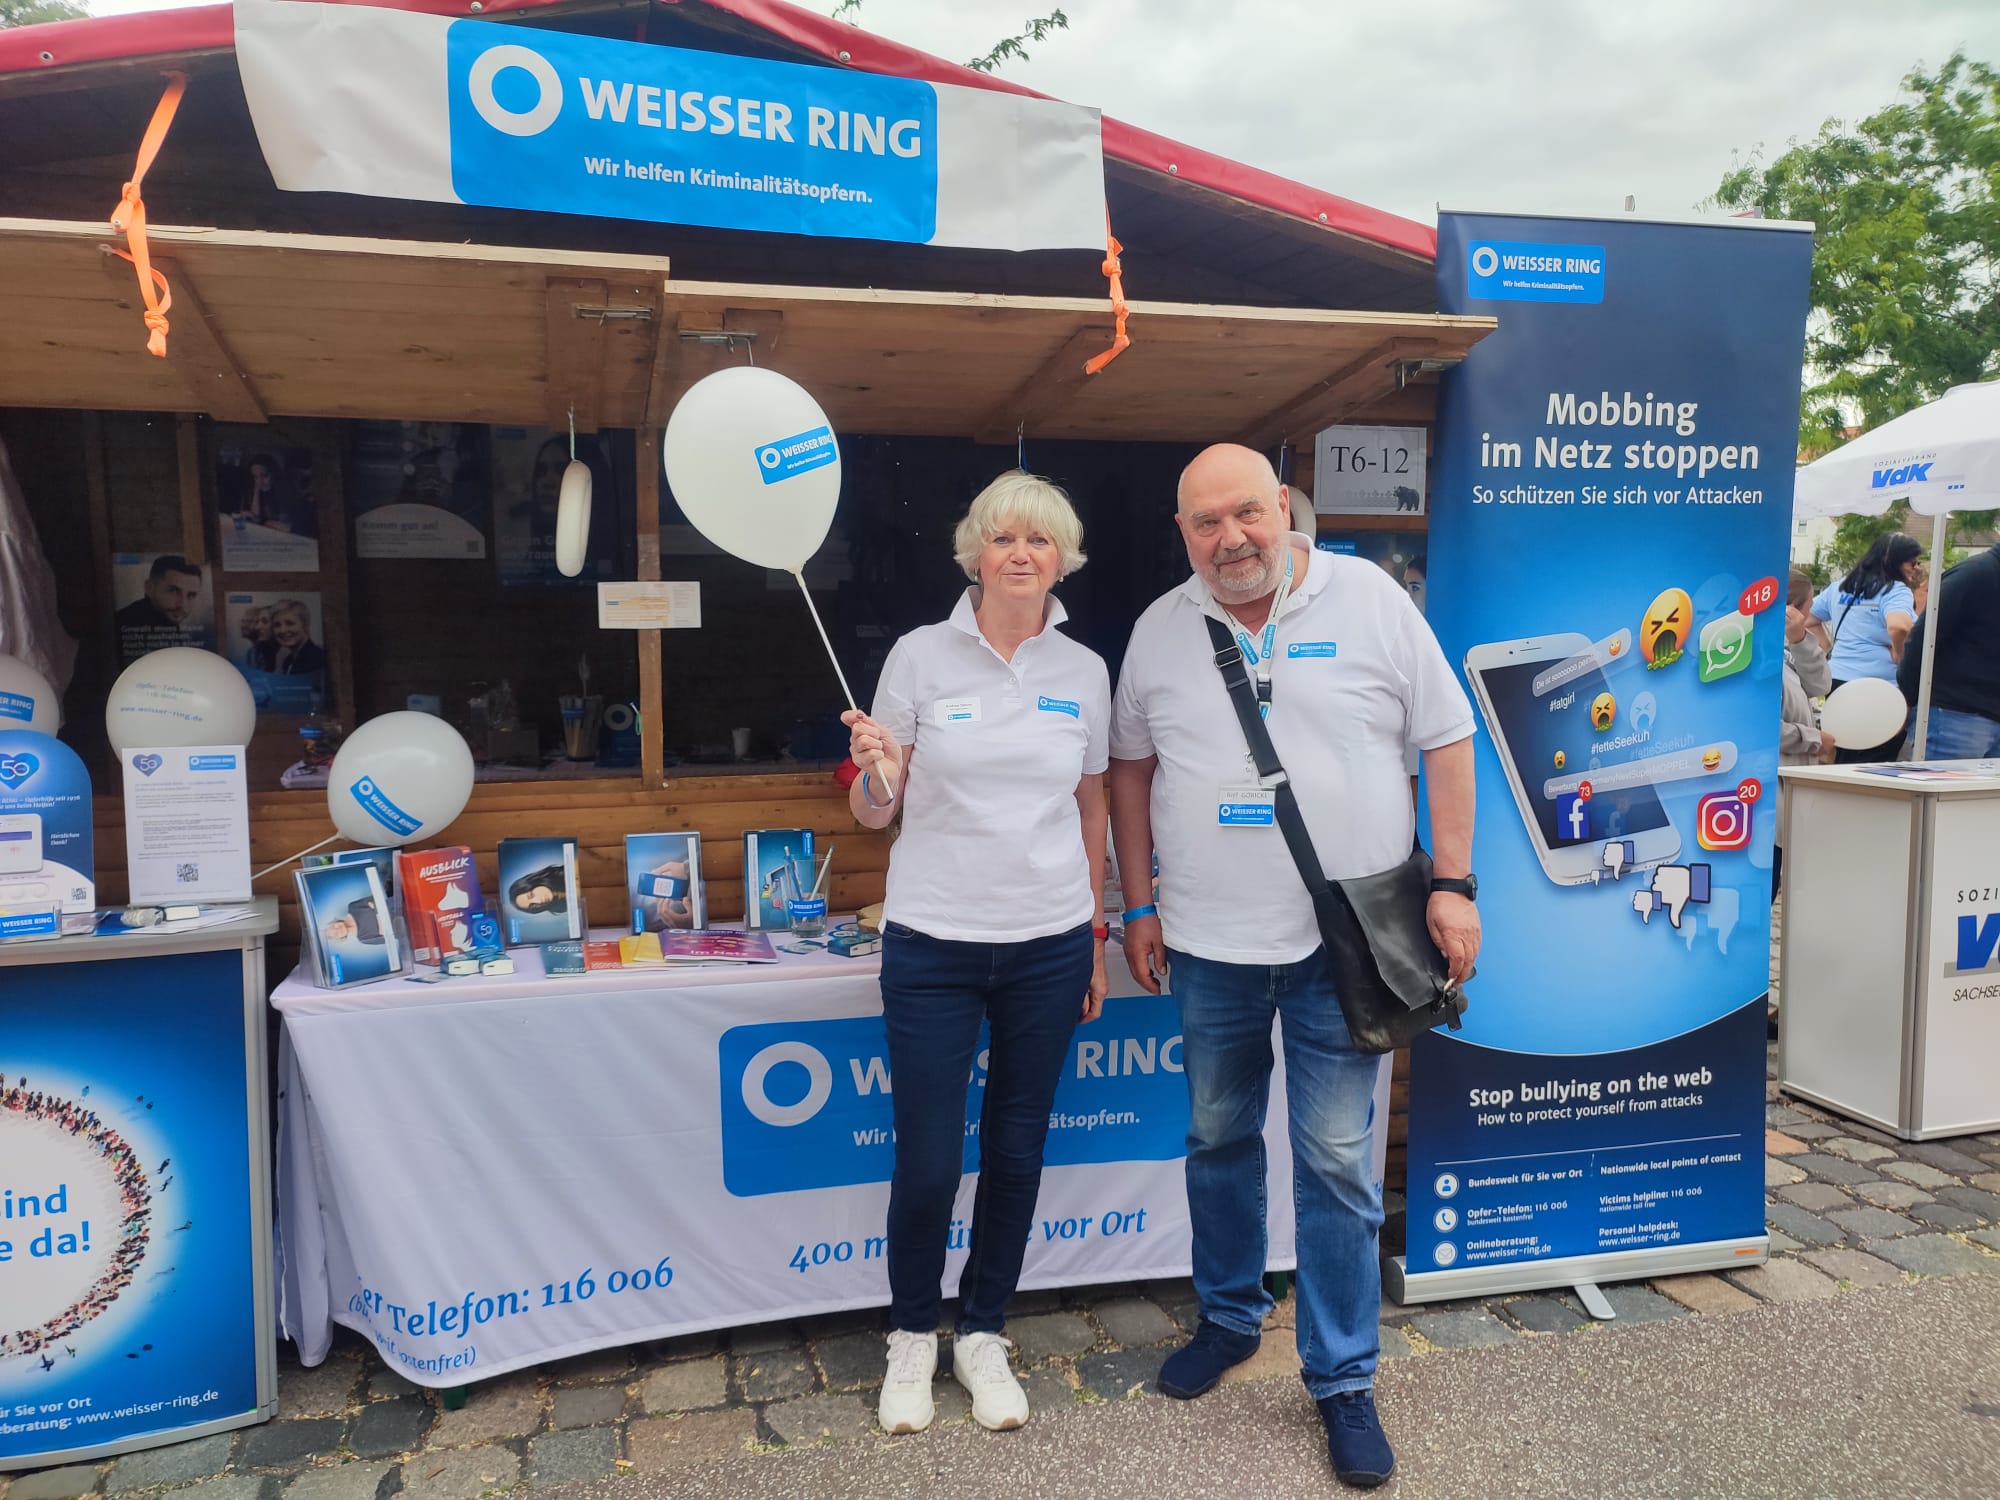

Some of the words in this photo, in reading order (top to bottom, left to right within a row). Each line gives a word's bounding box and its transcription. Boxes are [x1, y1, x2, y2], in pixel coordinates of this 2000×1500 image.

[579, 77, 795, 143] WEISSER
[808, 106, 921, 158] RING
[584, 156, 620, 177] Wir
[624, 159, 684, 184] helfen
[690, 167, 873, 203] Kriminalitätsopfern.
[1502, 255, 1562, 273] WEISSER
[1565, 258, 1600, 274] RING
[1546, 391, 1698, 436] Mobbing
[781, 438, 819, 458] WEISSER
[1481, 433, 1521, 468] im
[1534, 436, 1612, 469] Netz
[1624, 439, 1759, 479] stoppen
[1331, 446, 1409, 474] T6-12
[1872, 462, 1934, 488] VdK
[1472, 485, 1494, 504] So
[1499, 485, 1575, 504] schützen
[1581, 485, 1606, 504] Sie
[1613, 485, 1647, 504] sich
[1653, 491, 1681, 504] vor
[1685, 485, 1763, 504] Attacken
[1744, 585, 1771, 609] 118
[0, 760, 30, 780] 50
[1580, 786, 1590, 797] 73
[1739, 784, 1757, 798] 20
[371, 793, 400, 820] WEISSER
[398, 818, 418, 830] RING
[419, 857, 470, 878] AUSBLICK
[2, 919, 33, 928] WEISSER
[34, 917, 52, 925] RING
[1469, 1087, 1514, 1108] Stop
[1521, 1079, 1602, 1104] bullying
[1607, 1078, 1631, 1095] on
[1638, 1071, 1668, 1092] the
[1674, 1066, 1712, 1087] web
[1478, 1112, 1505, 1126] How
[1509, 1110, 1523, 1123] to
[1527, 1106, 1572, 1125] protect
[1575, 1100, 1626, 1122] yourself
[1628, 1098, 1656, 1112] from
[1660, 1093, 1703, 1109] attacks
[852, 1128, 887, 1147] Wir
[1600, 1161, 1649, 1175] Nationwide
[1650, 1159, 1670, 1170] local
[1671, 1156, 1698, 1170] points
[1699, 1155, 1709, 1164] of
[1710, 1153, 1742, 1164] contact
[1468, 1173, 1519, 1188] Bundesweit
[1521, 1172, 1535, 1184] für
[1537, 1171, 1550, 1181] Sie
[1551, 1170, 1566, 1180] vor
[1568, 1168, 1583, 1178] Ort
[0, 1184, 67, 1219] ind
[1600, 1194, 1631, 1206] Victims
[1633, 1190, 1669, 1204] helpline:
[1670, 1188, 1684, 1198] 116
[1686, 1186, 1702, 1196] 006
[1467, 1204, 1533, 1219] Opfer-Telefon:
[1535, 1201, 1548, 1212] 116
[1551, 1200, 1568, 1210] 006
[1599, 1204, 1632, 1213] nationwide
[1644, 1201, 1656, 1209] free
[1467, 1217, 1501, 1226] bundesweit
[1599, 1224, 1635, 1237] Personal
[1638, 1220, 1679, 1235] helpdesk:
[30, 1220, 90, 1257] da!
[789, 1241, 853, 1273] 400
[1041, 1214, 1093, 1242] vor
[1101, 1207, 1147, 1237] Ort
[1466, 1236, 1539, 1250] Onlineberatung:
[1598, 1230, 1681, 1247] www.weisser-ring.de
[1466, 1243, 1552, 1261] www.weisser-ring.de
[387, 1288, 529, 1339] Telefon:
[541, 1267, 596, 1308] 116
[607, 1256, 673, 1294] 006
[399, 1345, 476, 1375] ostenfrei)
[14, 1404, 36, 1417] Sie
[39, 1402, 64, 1414] vor
[67, 1397, 92, 1409] Ort
[76, 1389, 219, 1425] www.weisser-ring.de
